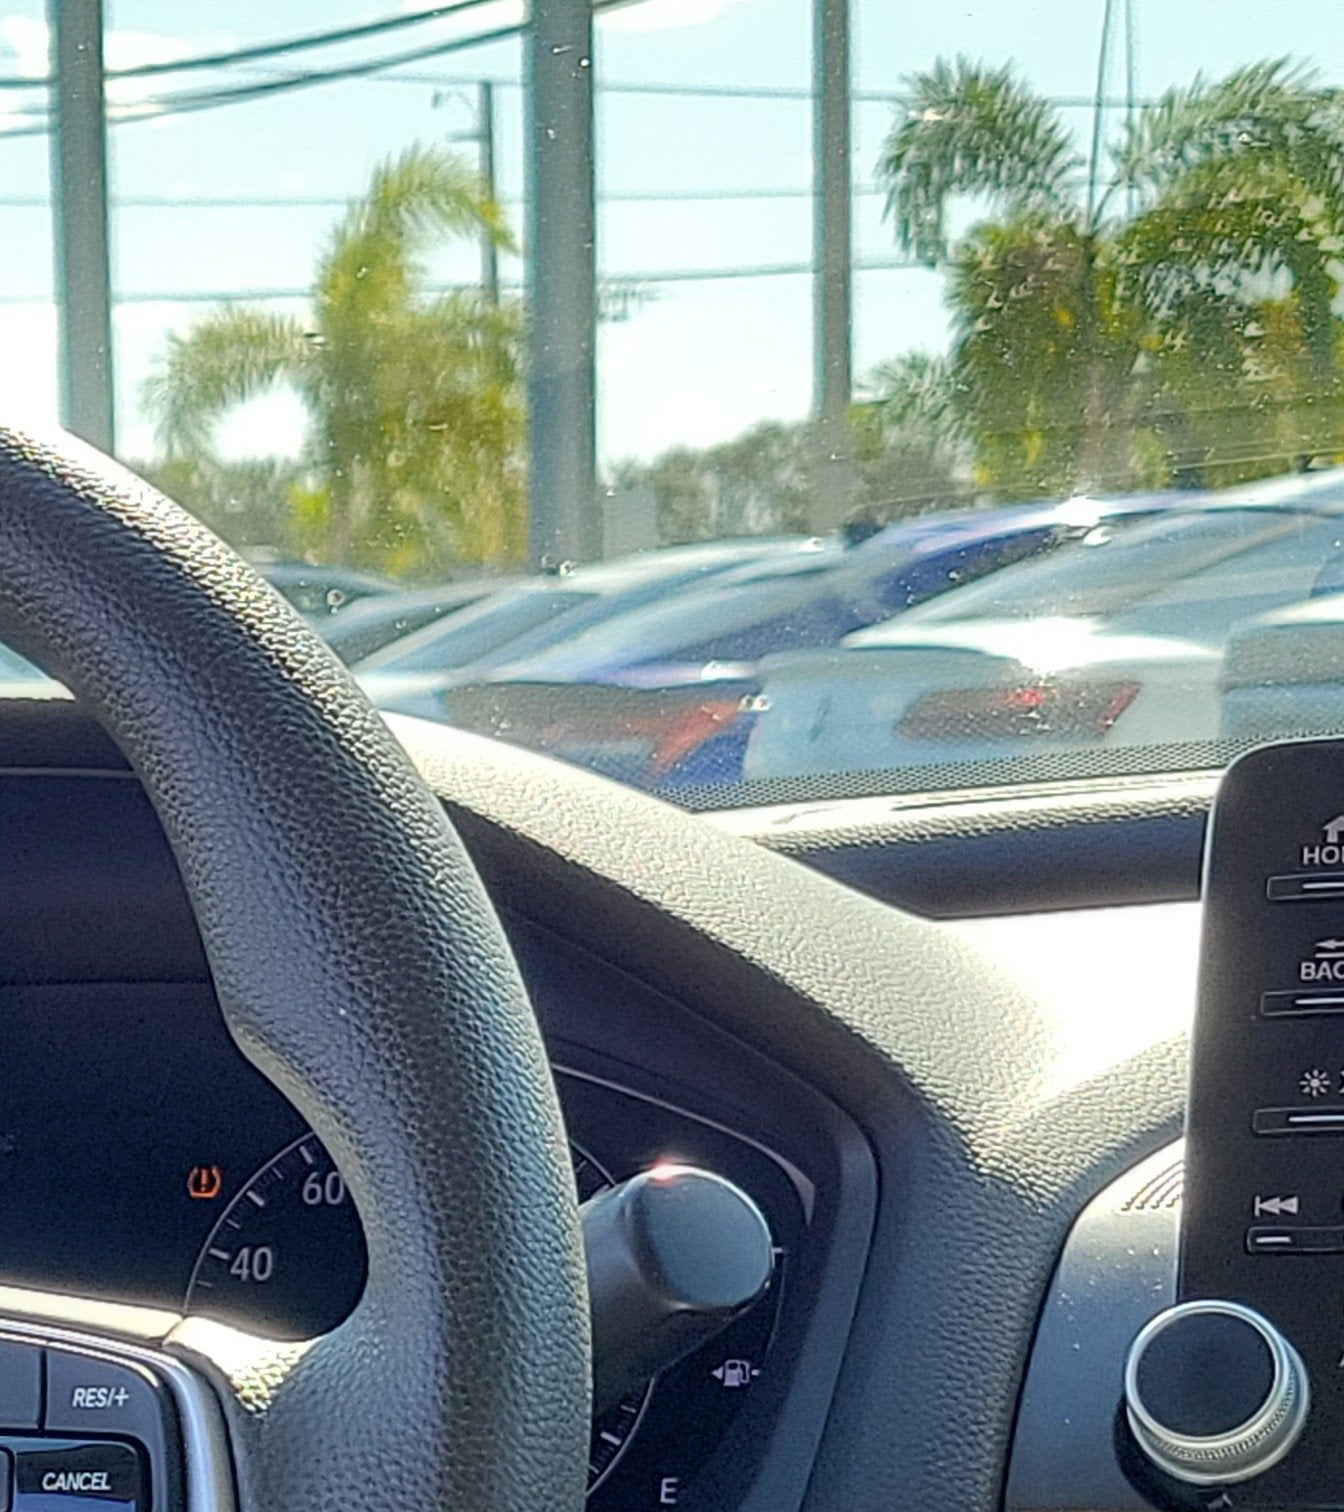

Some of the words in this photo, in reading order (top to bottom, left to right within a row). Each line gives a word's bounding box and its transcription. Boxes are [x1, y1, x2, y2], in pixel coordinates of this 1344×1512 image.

[1302, 845, 1344, 865] HO
[302, 1171, 344, 1205] 60
[230, 1247, 273, 1281] 40
[72, 1387, 130, 1411] RES/+
[41, 1472, 112, 1492] CANCEL
[659, 1477, 678, 1505] E
